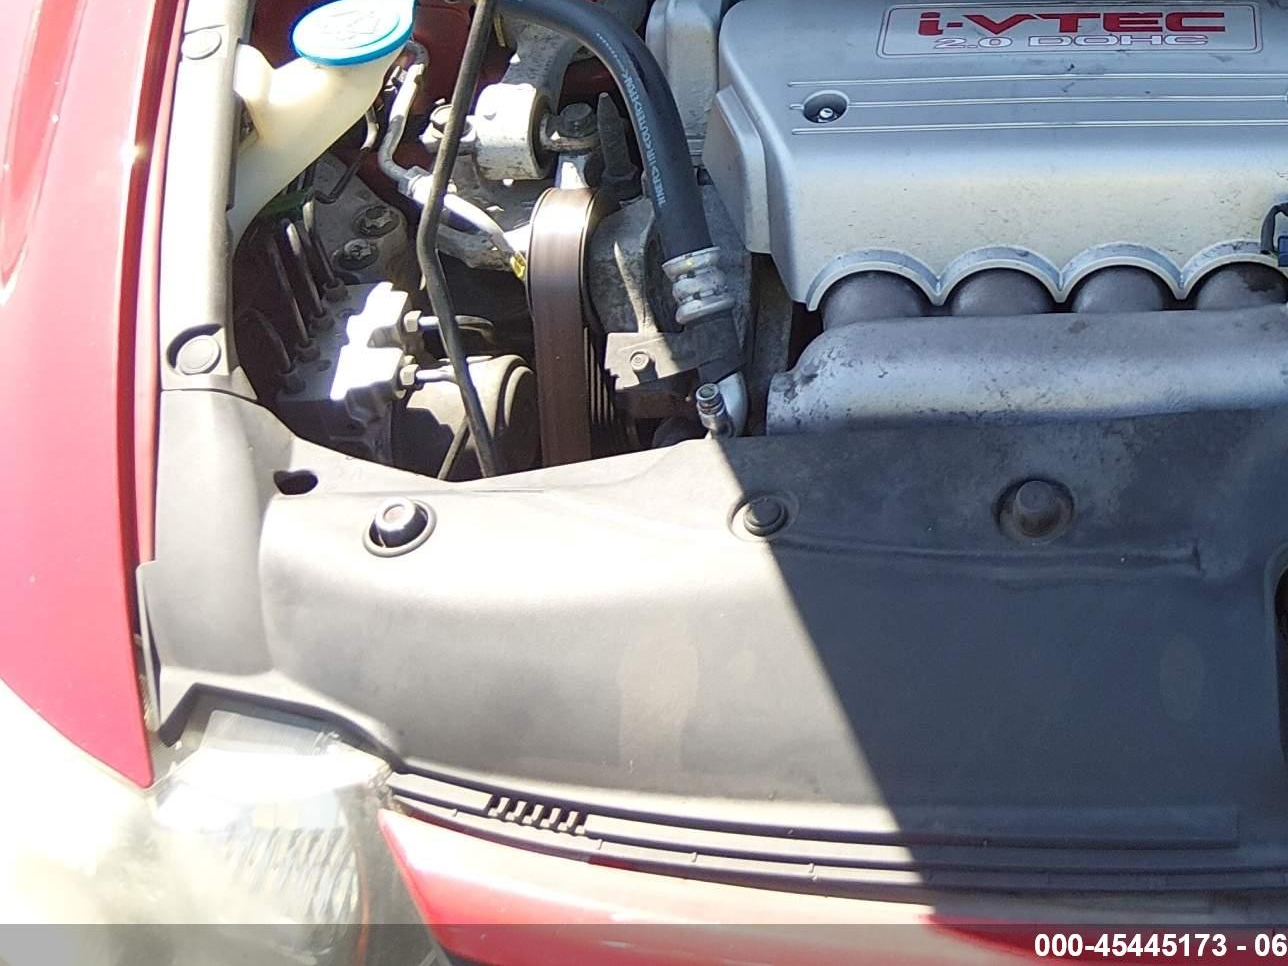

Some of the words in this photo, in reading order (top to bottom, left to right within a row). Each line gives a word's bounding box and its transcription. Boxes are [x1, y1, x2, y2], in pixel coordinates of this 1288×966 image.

[918, 11, 1226, 36] i-VTEC
[933, 36, 1013, 49] 2.0
[1027, 35, 1209, 48] DOHC
